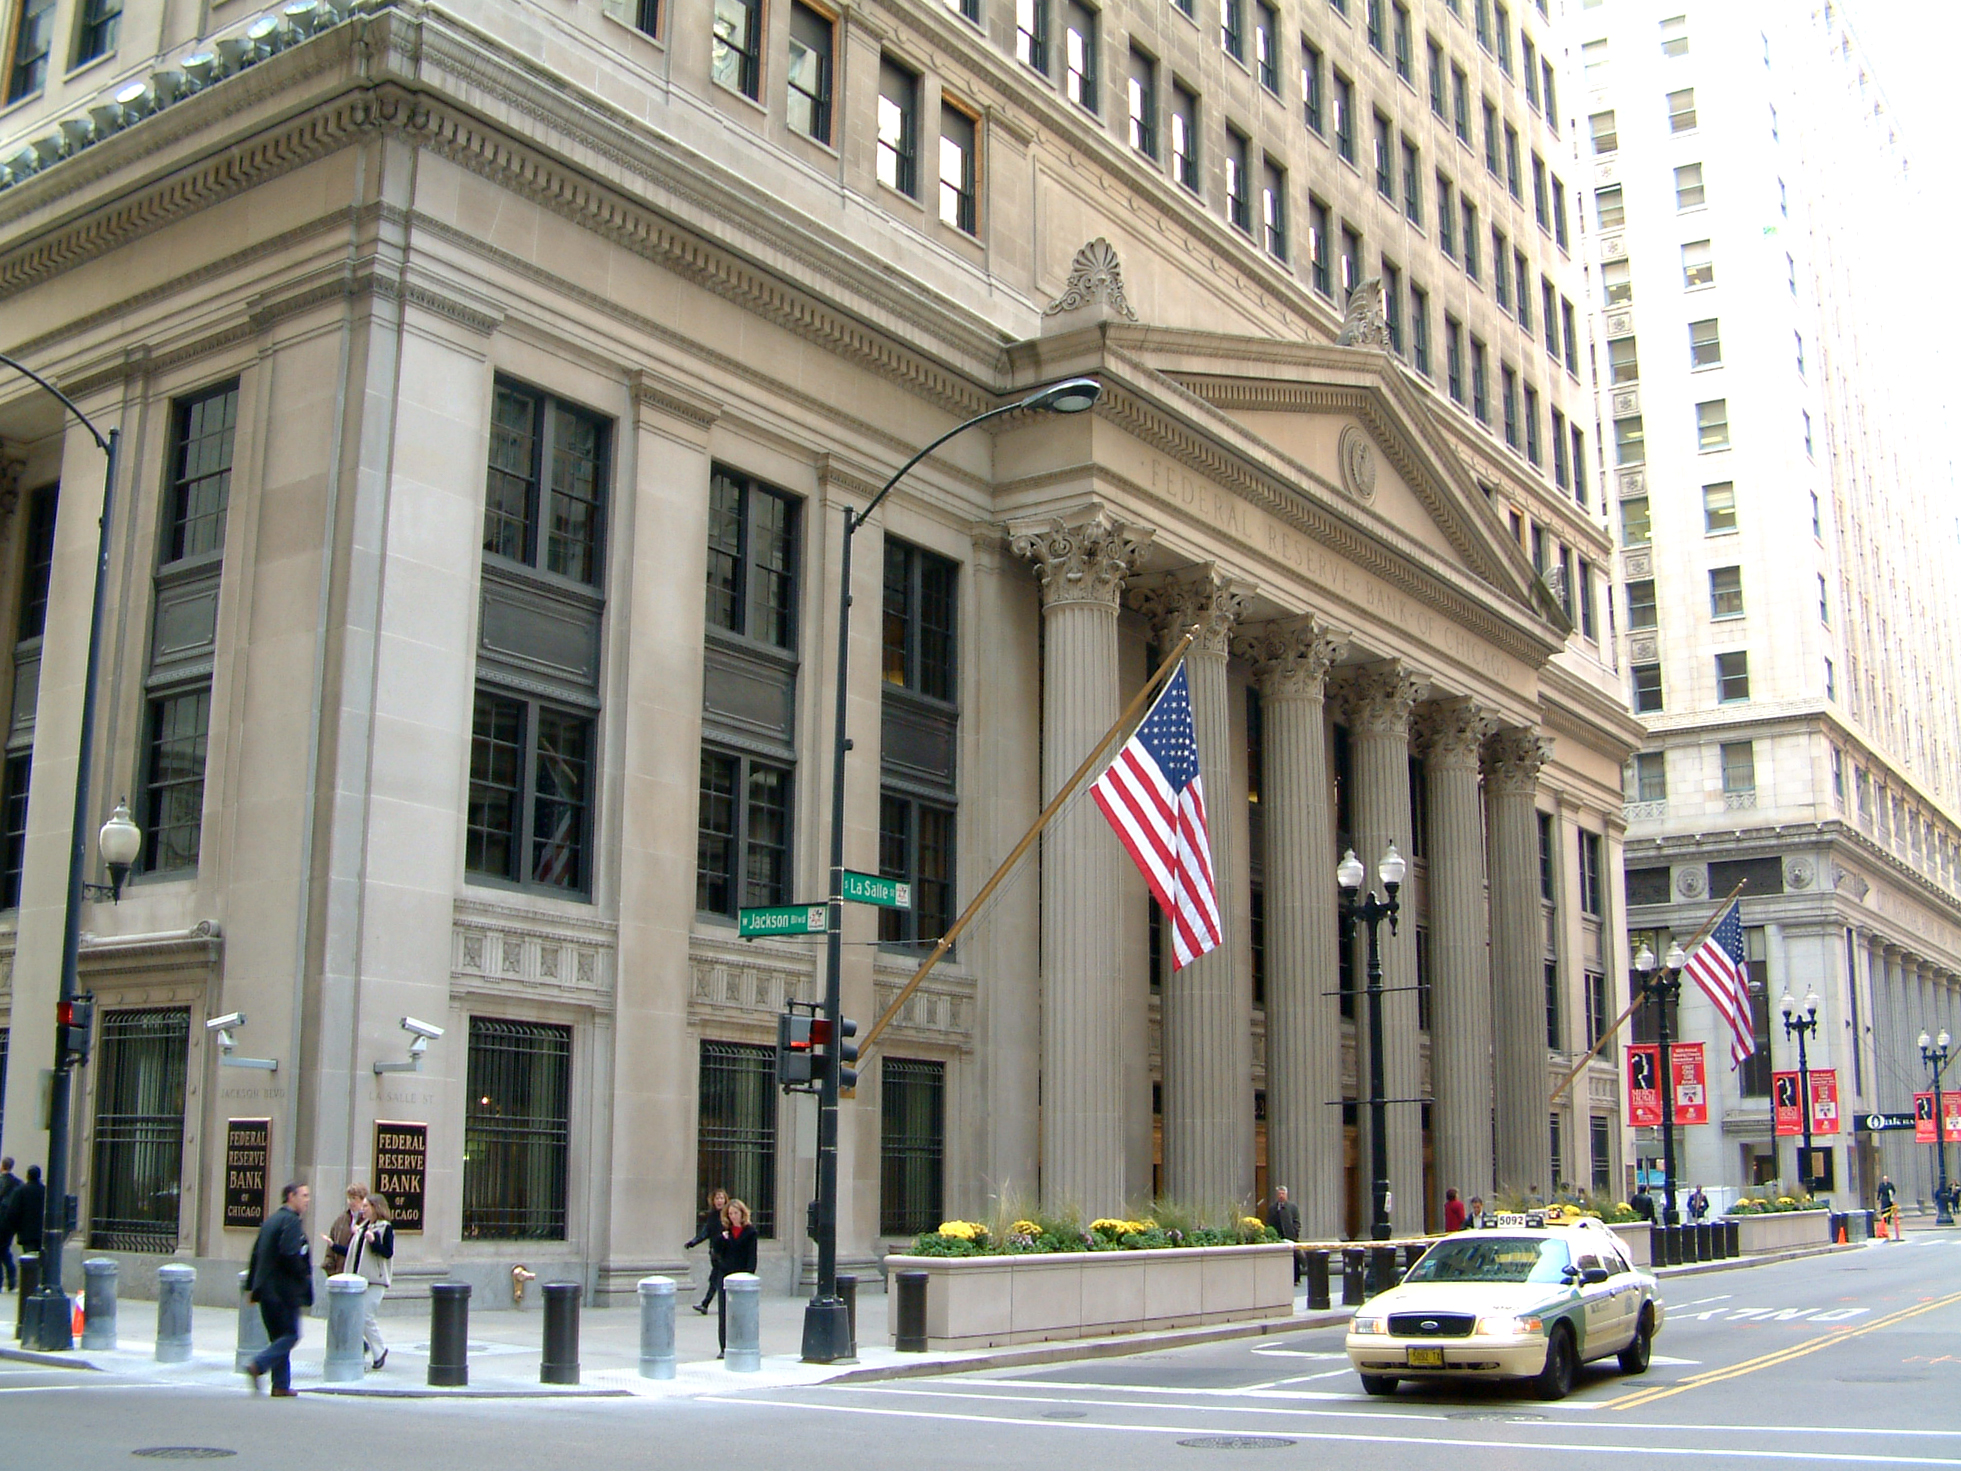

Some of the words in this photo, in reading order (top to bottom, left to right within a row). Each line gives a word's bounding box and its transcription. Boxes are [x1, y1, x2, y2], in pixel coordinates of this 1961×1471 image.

[1151, 458, 1253, 541] FEDERAL
[1267, 524, 1353, 594] RESERVE
[1366, 585, 1407, 623] BANK
[1417, 612, 1434, 637] OF
[1444, 627, 1512, 682] CHICAGO
[850, 877, 862, 895] La
[864, 880, 888, 900] Salle
[741, 918, 748, 926] W
[749, 913, 789, 930] Jackson
[790, 913, 806, 924] Blvd
[221, 1087, 259, 1100] JACKSON
[263, 1087, 285, 1099] BLVD
[368, 1091, 382, 1101] LA
[385, 1093, 416, 1103] SALLE
[423, 1094, 433, 1104] ST
[1866, 1114, 1902, 1130] Oak
[229, 1130, 266, 1146] FEDERAL
[378, 1134, 425, 1151] FEDERAL
[228, 1150, 265, 1167] RESERVE
[378, 1153, 424, 1170] RESERVE
[229, 1172, 263, 1189] BANK
[380, 1174, 421, 1193] BANK
[240, 1193, 249, 1202] OF
[395, 1197, 405, 1206] OF
[227, 1205, 261, 1218] CHICAGO
[391, 1208, 419, 1221] ICAGO
[1499, 1215, 1524, 1226] 5092
